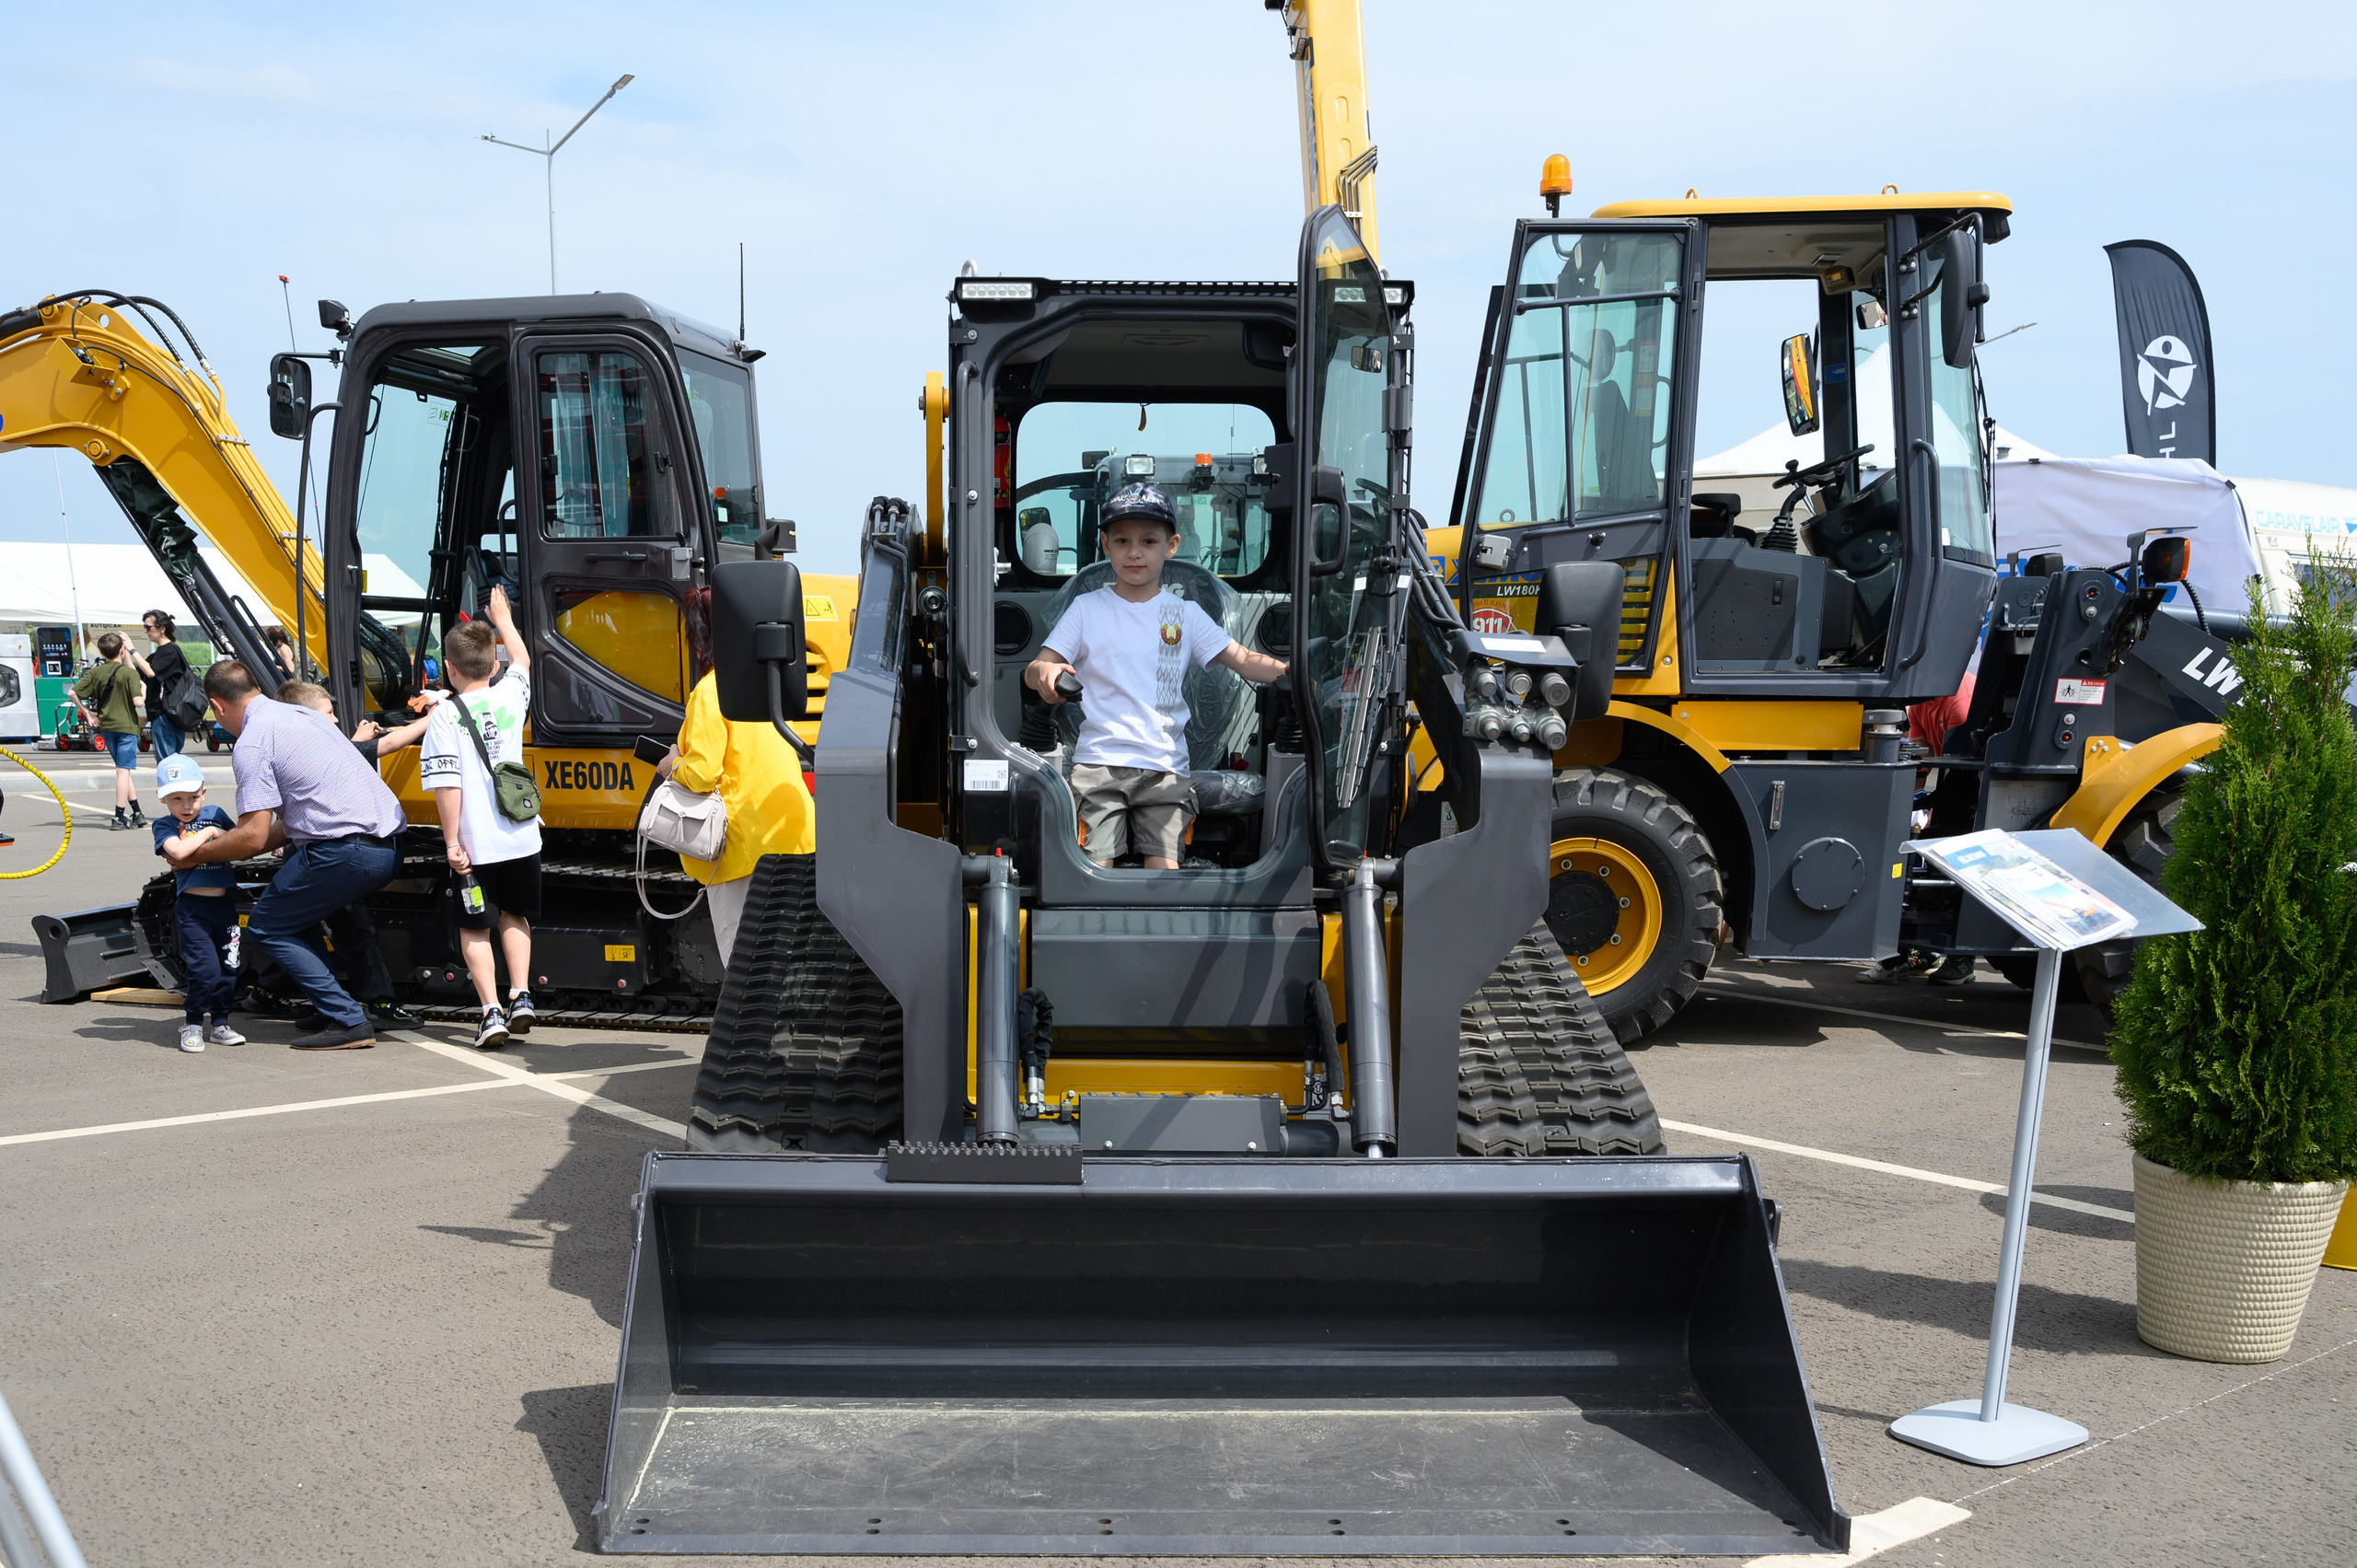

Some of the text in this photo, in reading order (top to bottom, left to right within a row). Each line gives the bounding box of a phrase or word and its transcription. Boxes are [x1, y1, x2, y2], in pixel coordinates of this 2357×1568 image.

[2256, 509, 2341, 533] CARAVELAIR
[1472, 599, 1513, 611] ОМПАНИЯ
[1472, 617, 1503, 633] 911
[544, 761, 635, 791] XE60DA
